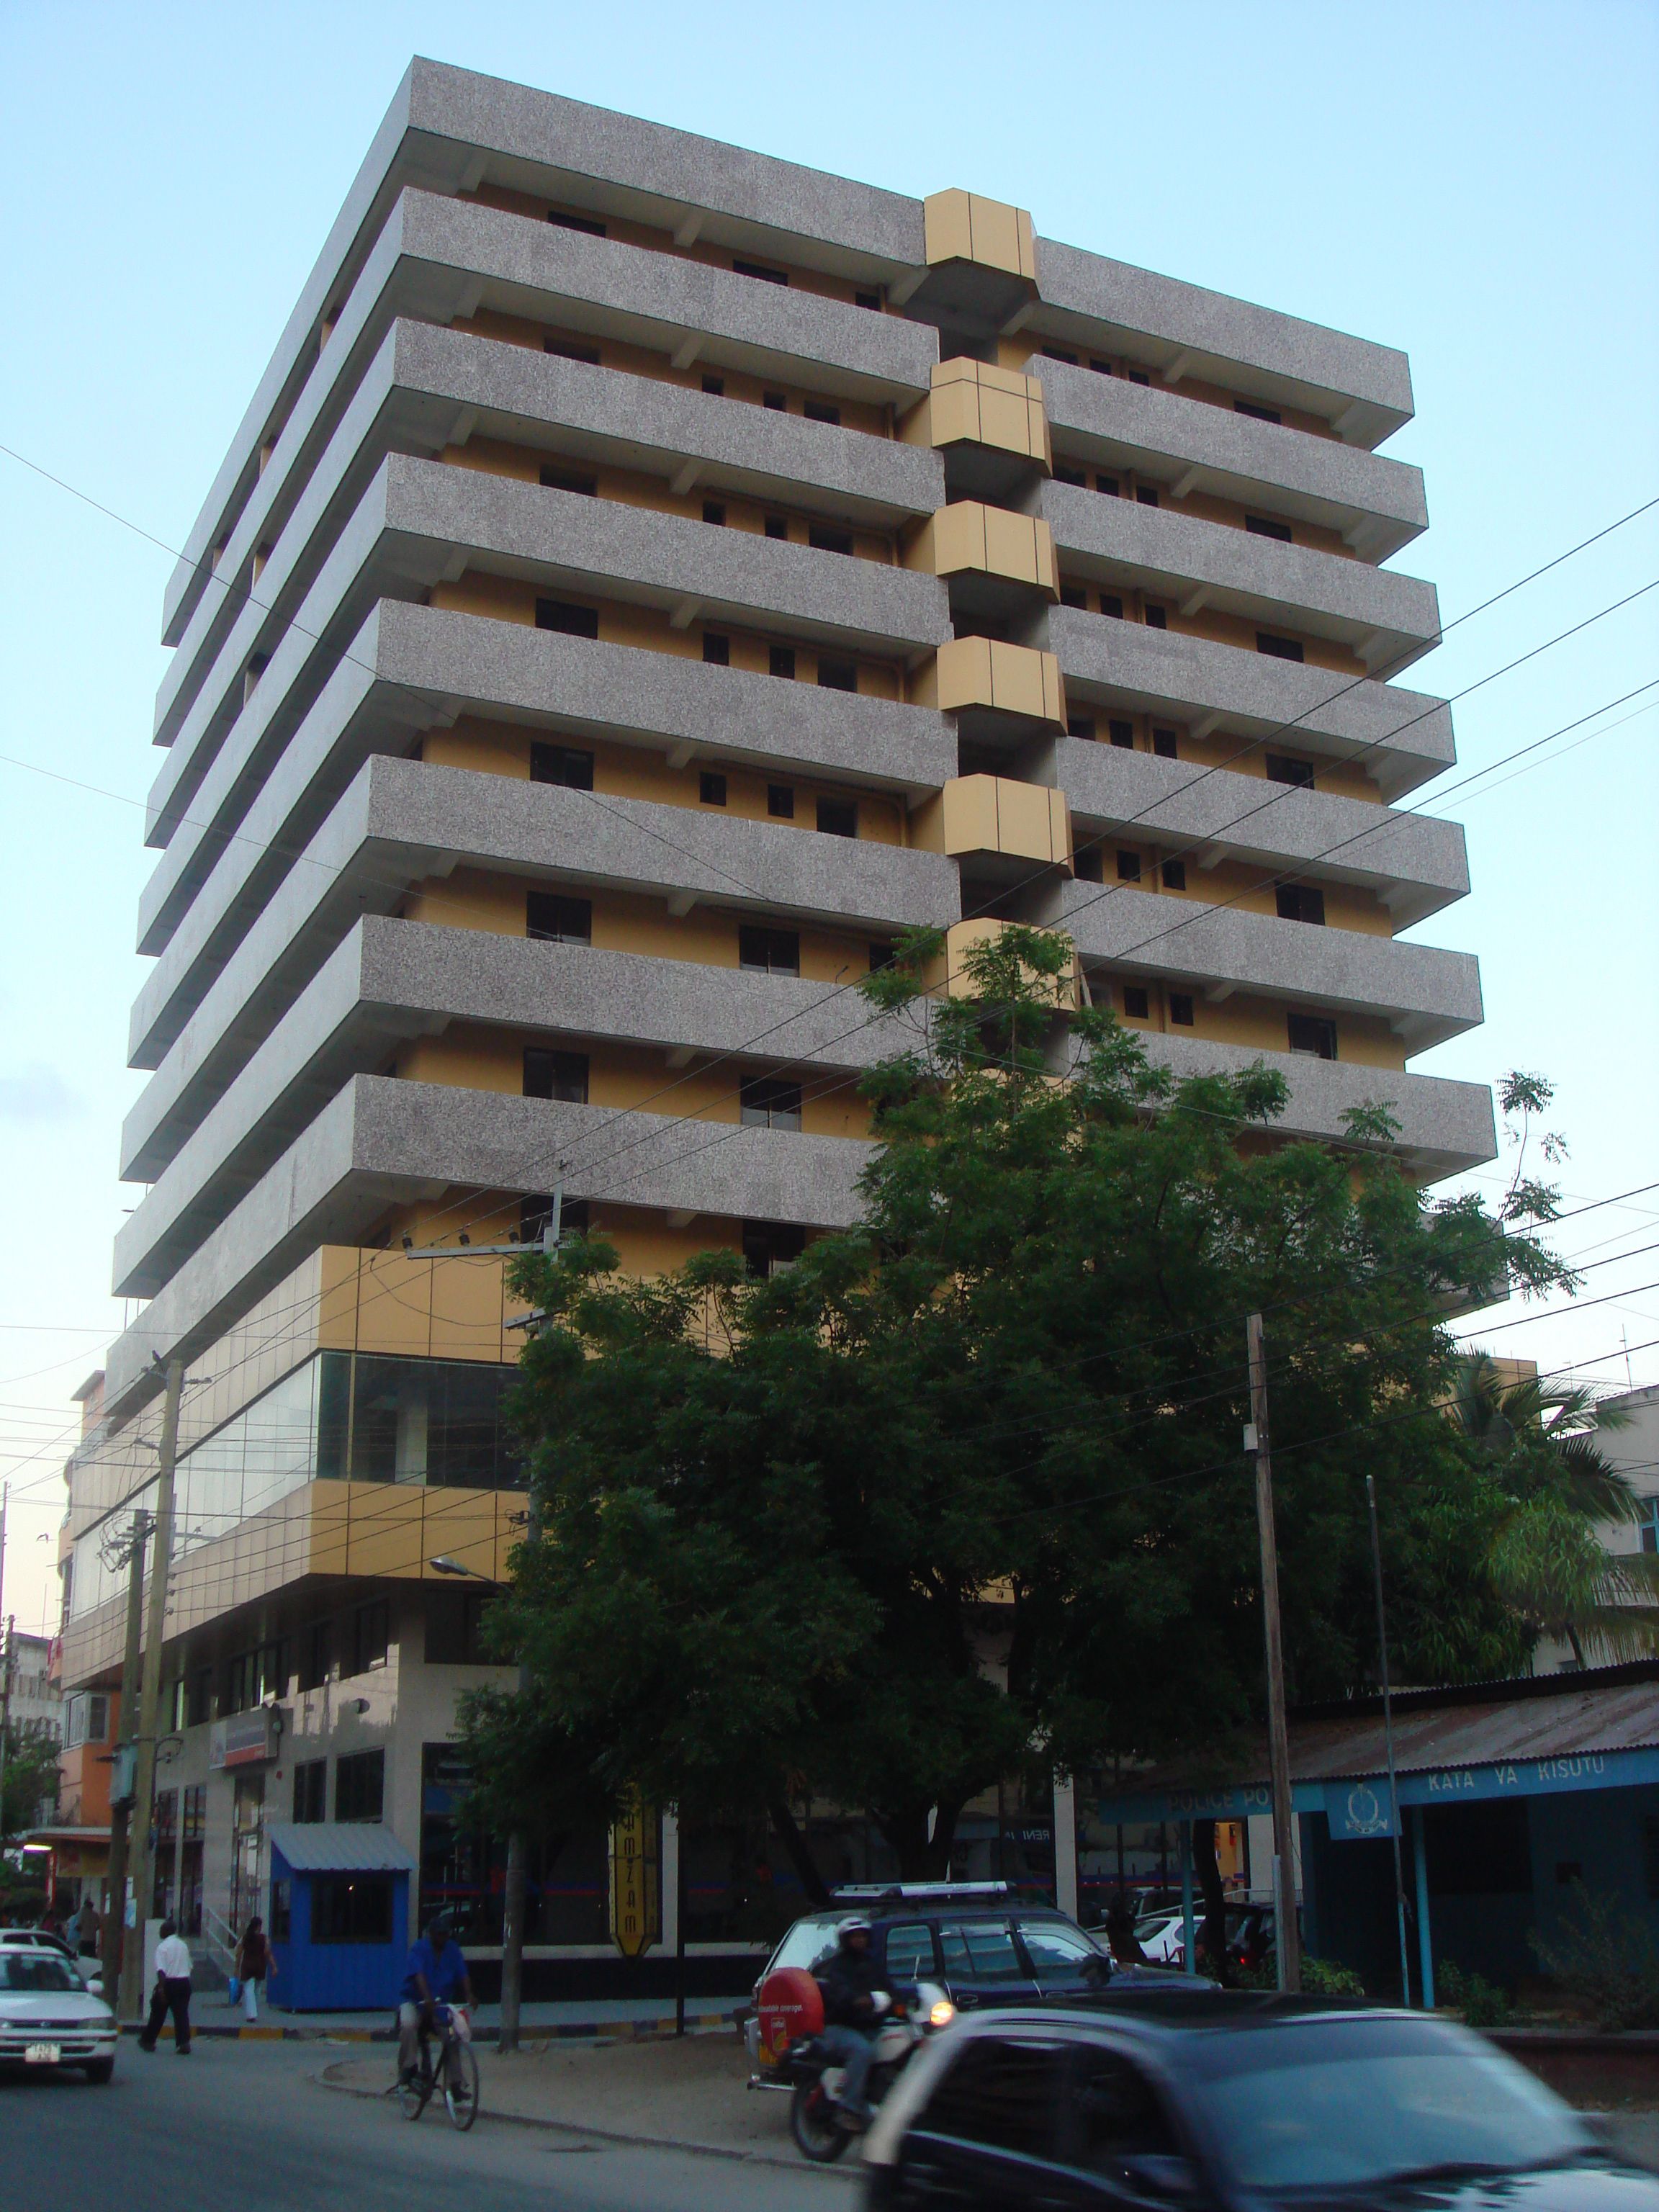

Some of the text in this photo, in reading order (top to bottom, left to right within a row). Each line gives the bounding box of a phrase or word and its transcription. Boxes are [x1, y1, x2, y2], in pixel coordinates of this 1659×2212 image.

[1428, 1755, 1604, 1791] KATA YA KISUTU
[1169, 1791, 1233, 1812] POLICE
